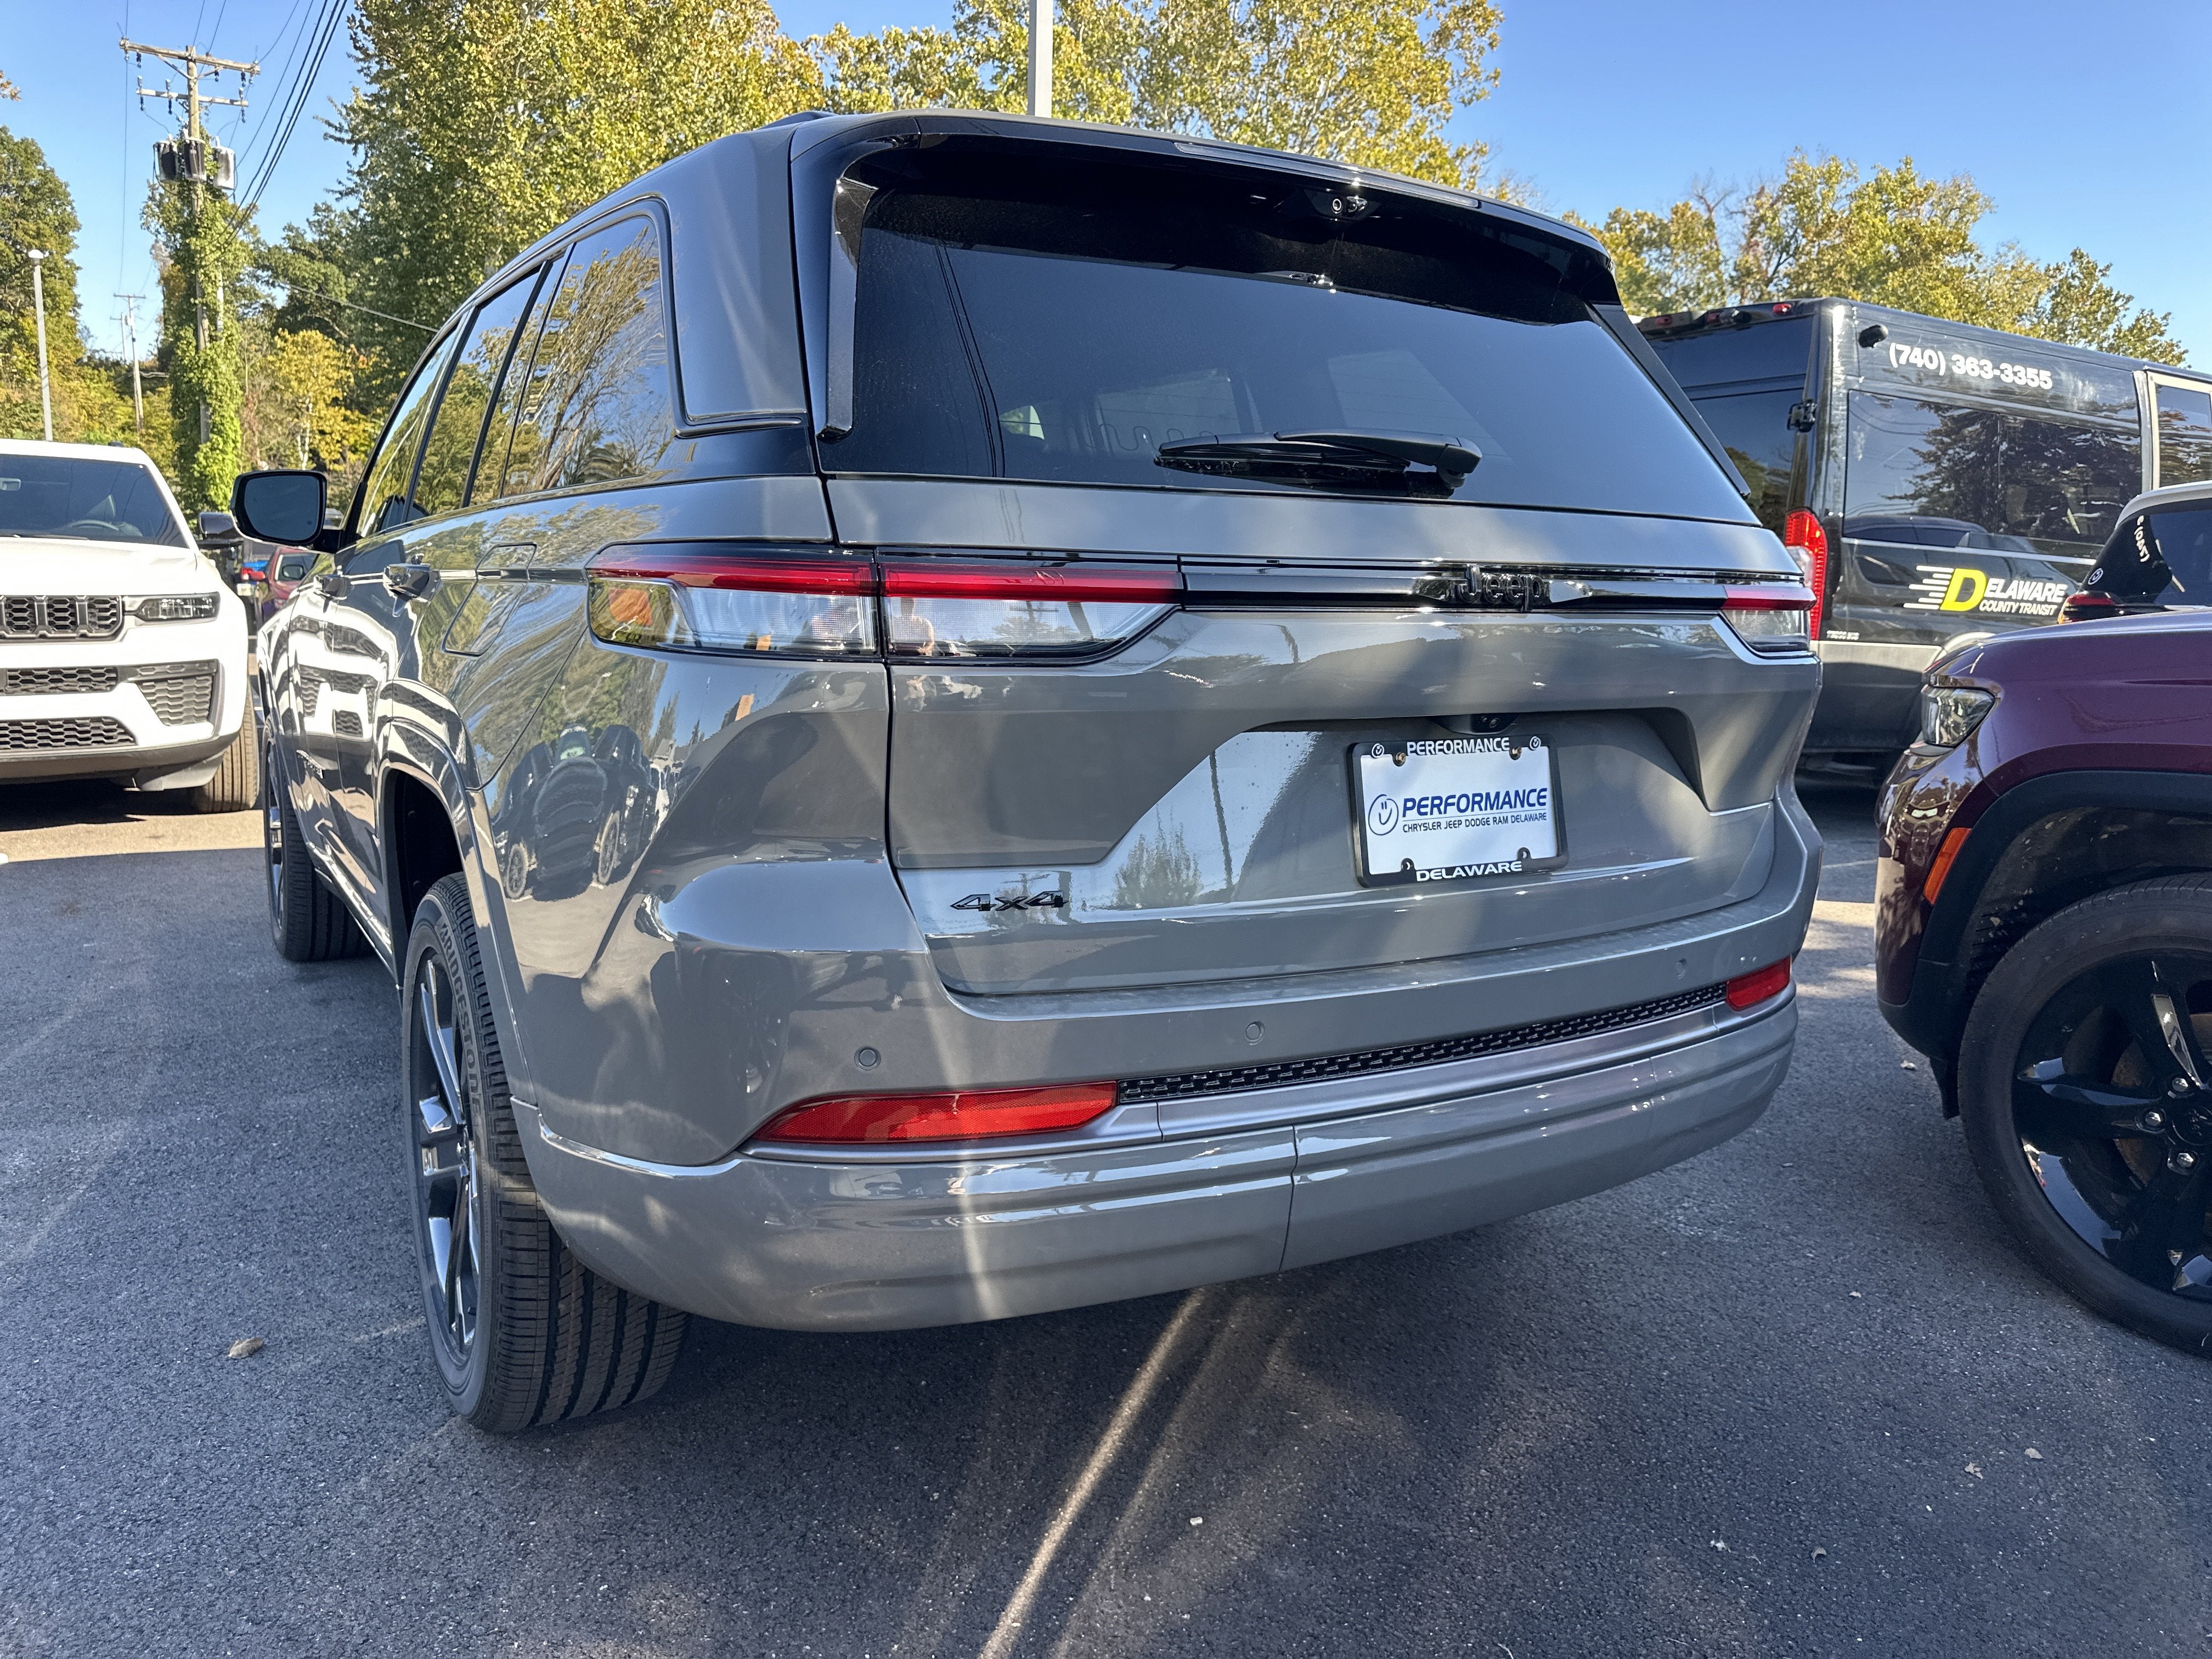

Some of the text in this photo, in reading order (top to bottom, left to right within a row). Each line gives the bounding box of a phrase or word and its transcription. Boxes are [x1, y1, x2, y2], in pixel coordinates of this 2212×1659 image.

[1889, 342, 2053, 390] (740) 363-3355
[1457, 563, 1545, 612] Jeep
[1979, 599, 2058, 616] COUNTY TRANSIT
[1406, 737, 1510, 756] PERFORMANCE
[1402, 787, 1548, 817] PERFORMANCE
[1403, 812, 1547, 833] CHRYSLER JEEP DODGE RAM DELAWARE
[1417, 861, 1522, 882] DELAWARE
[438, 921, 482, 1117] BRIDGESTONE
